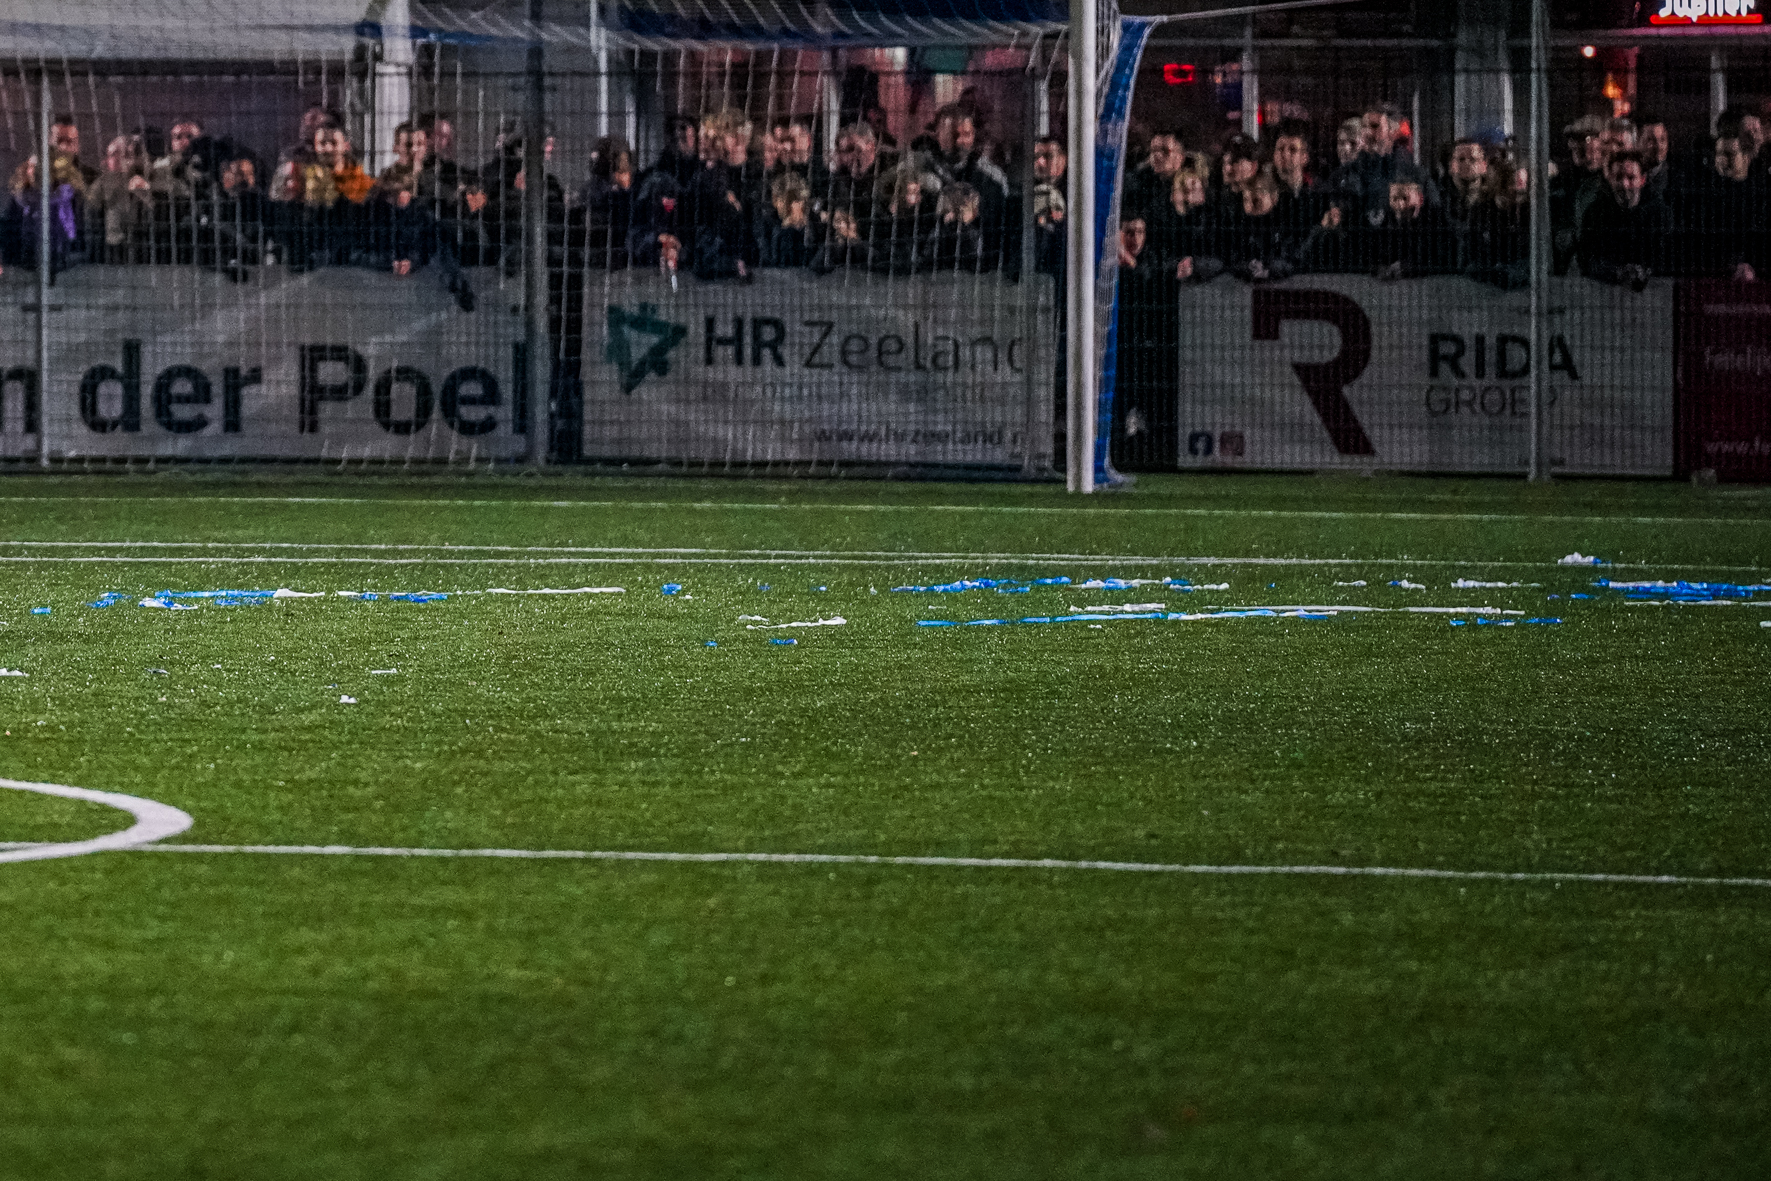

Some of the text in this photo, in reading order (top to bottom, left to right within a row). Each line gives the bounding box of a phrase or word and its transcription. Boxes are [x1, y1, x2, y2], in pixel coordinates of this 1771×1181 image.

[703, 317, 787, 367] HR
[1428, 332, 1581, 380] RIDA
[79, 339, 262, 434] der
[300, 339, 528, 435] Poel
